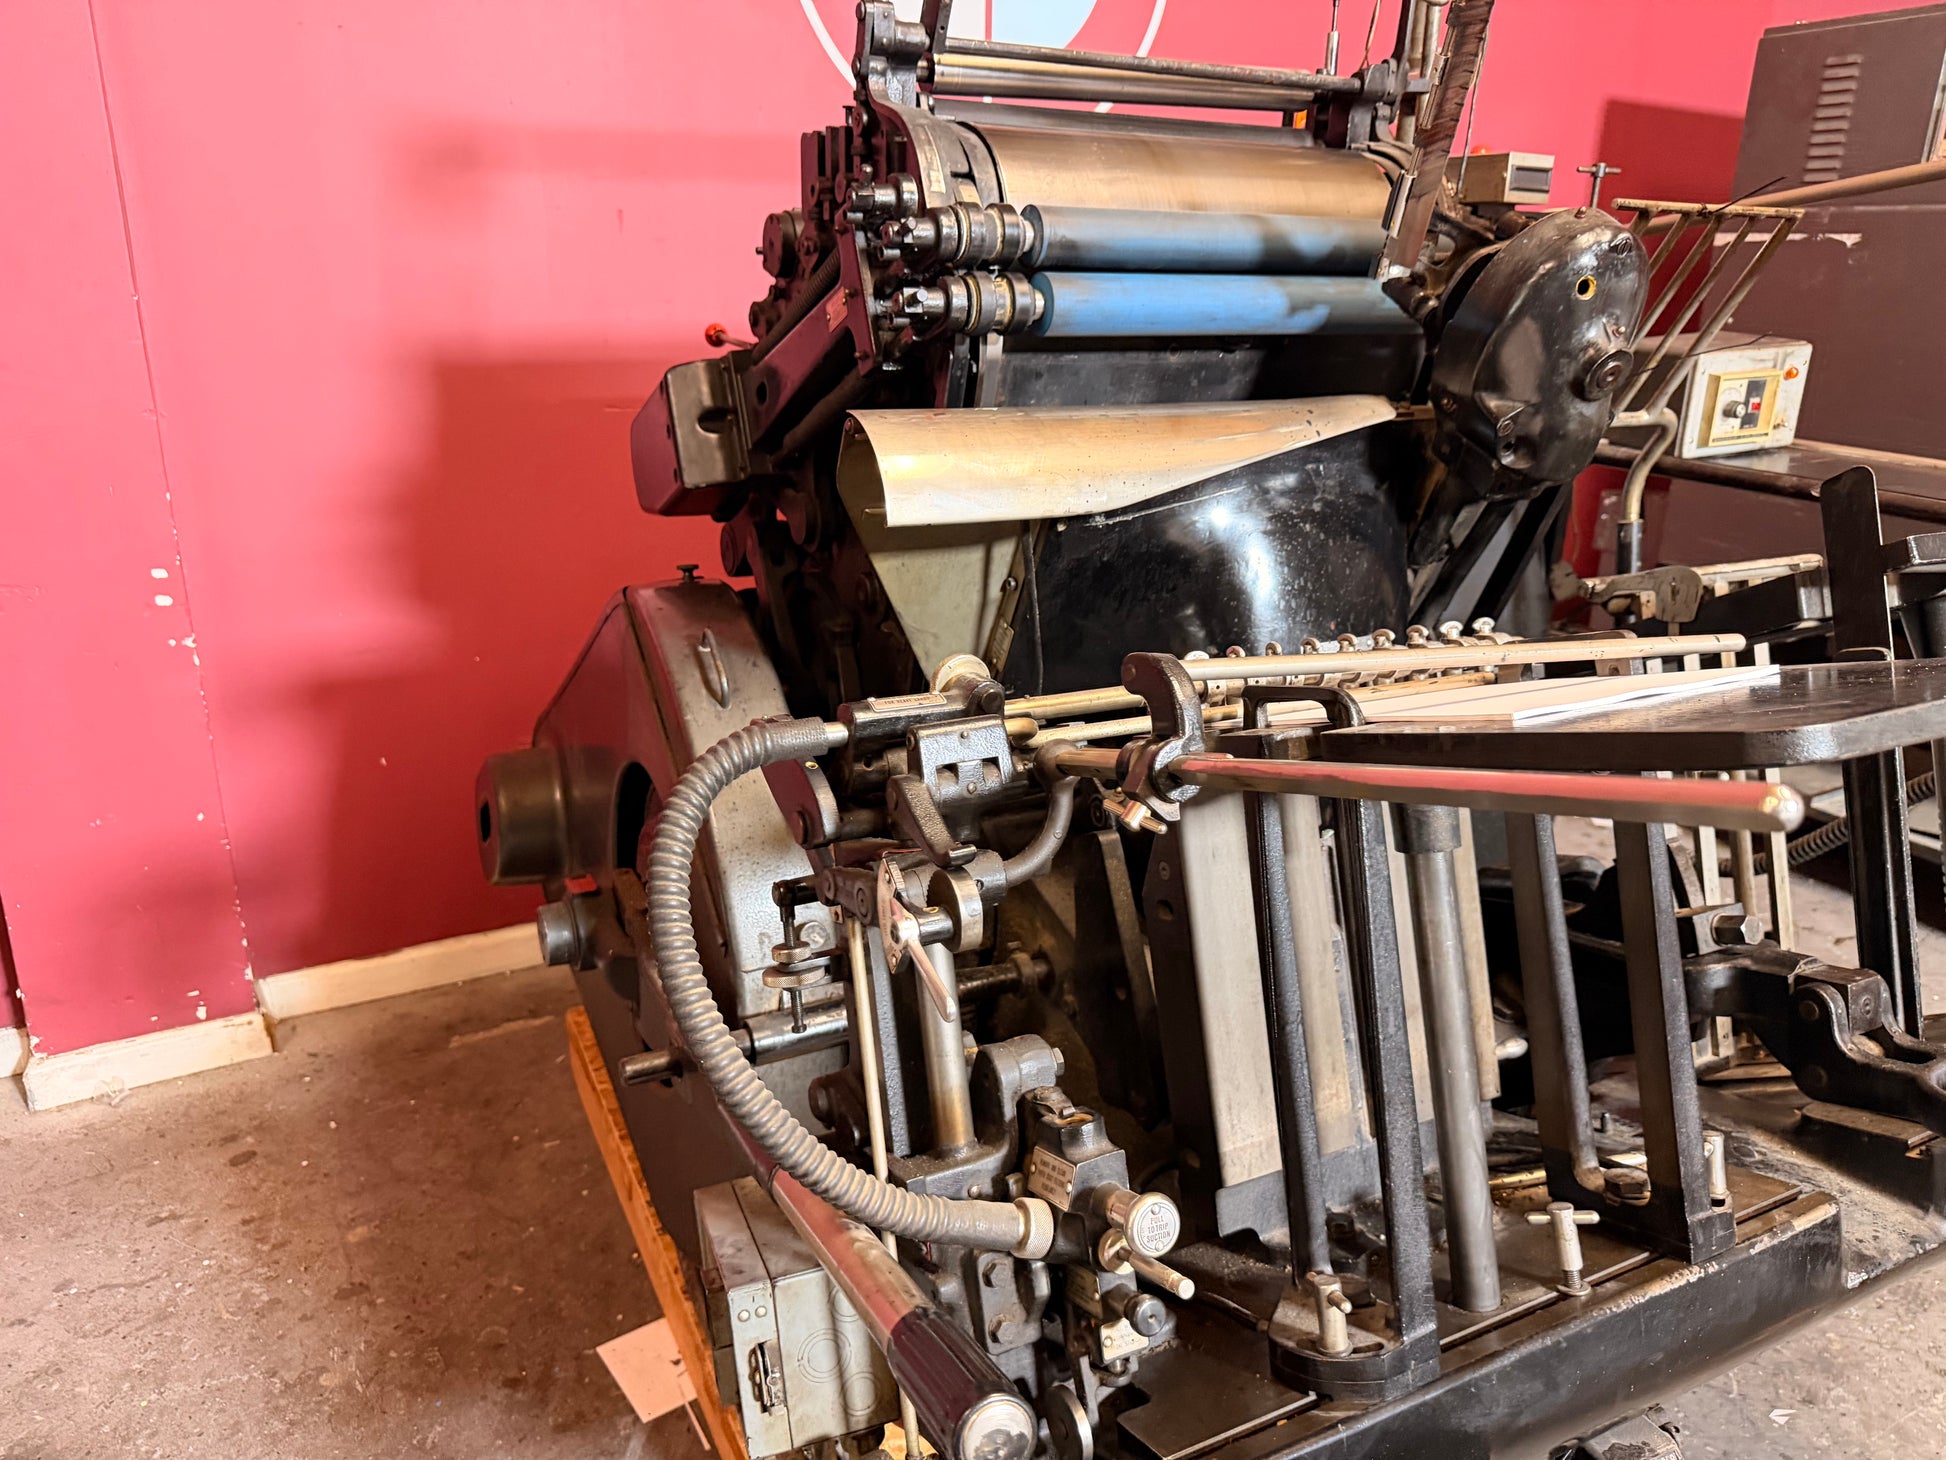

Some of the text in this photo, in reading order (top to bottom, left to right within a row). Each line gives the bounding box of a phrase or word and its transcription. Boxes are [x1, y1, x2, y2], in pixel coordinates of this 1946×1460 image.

[1150, 1215, 1164, 1225] PULL
[1147, 1222, 1169, 1234] TO TRIP
[1146, 1231, 1171, 1243] SUCTION
